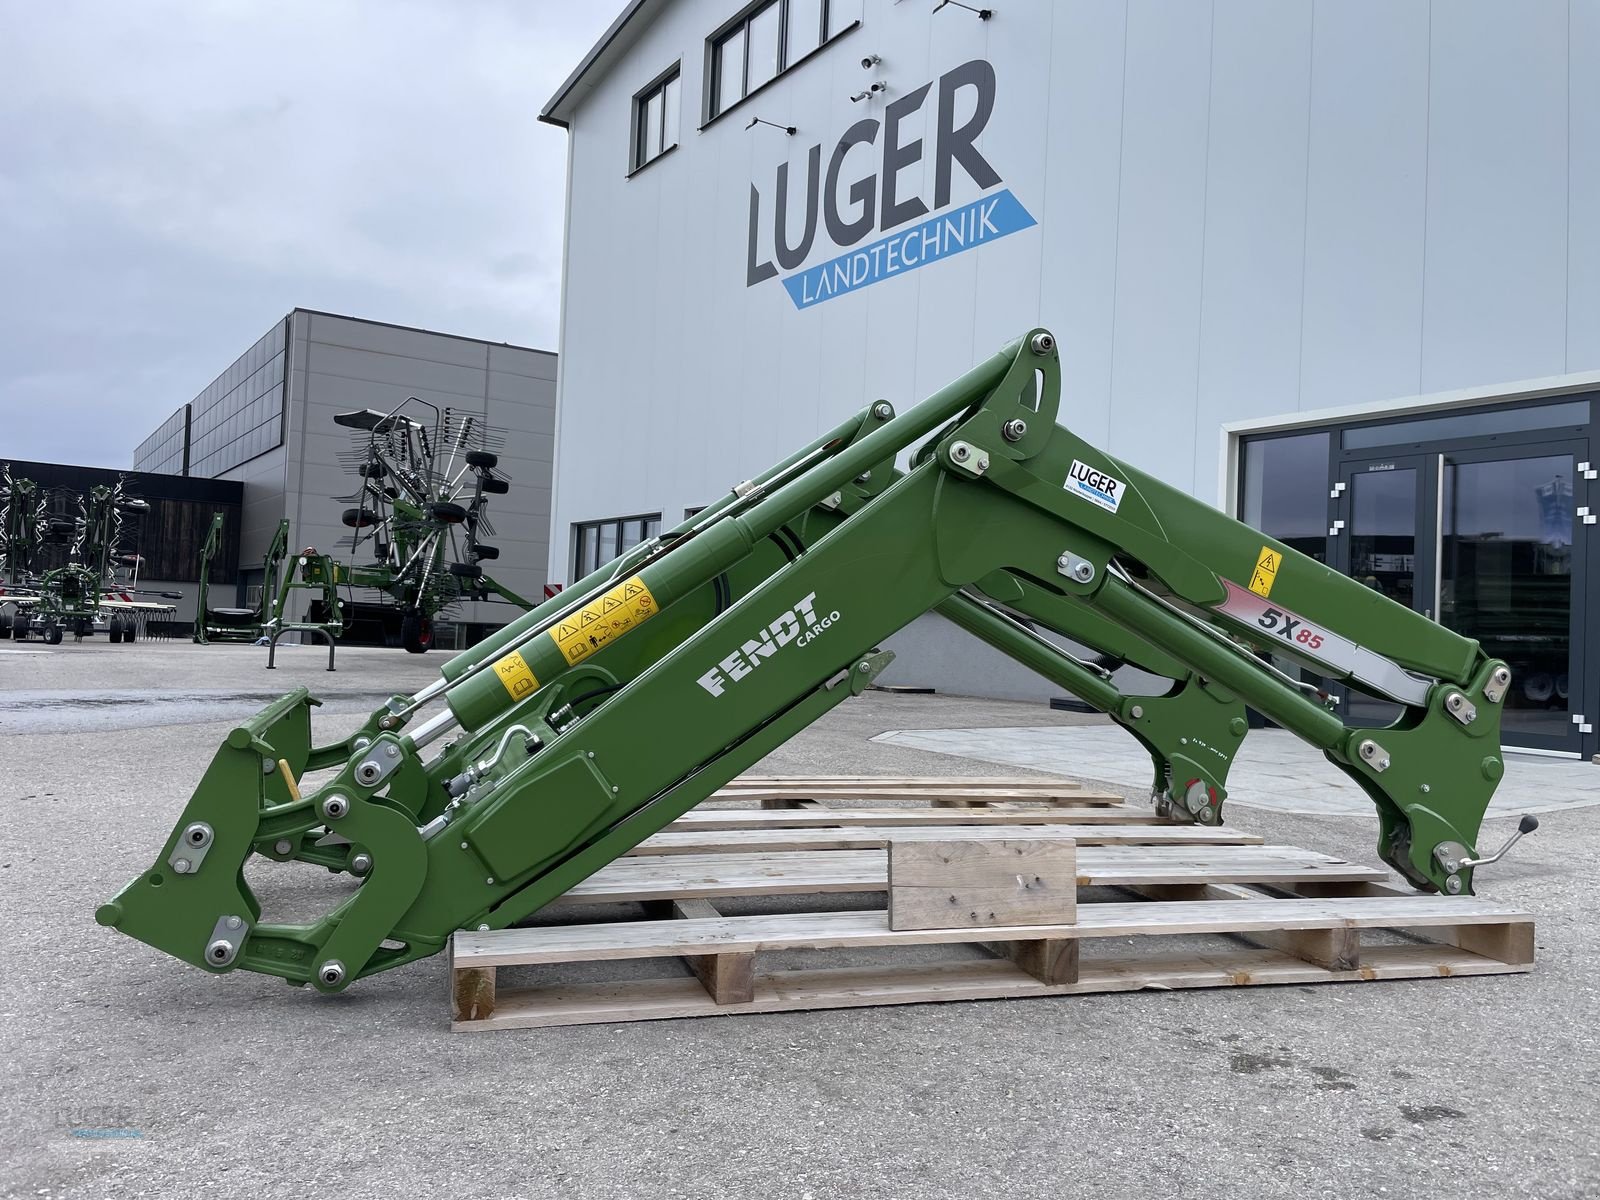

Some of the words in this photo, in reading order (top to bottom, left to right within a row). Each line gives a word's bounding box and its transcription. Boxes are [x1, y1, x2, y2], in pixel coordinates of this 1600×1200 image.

[747, 59, 1003, 287] LUGER
[802, 198, 1000, 304] LANDTECHNIK
[1069, 461, 1117, 498] LUGER
[696, 591, 816, 698] FENDT
[796, 610, 841, 648] CARGO
[1257, 607, 1325, 649] 5X85
